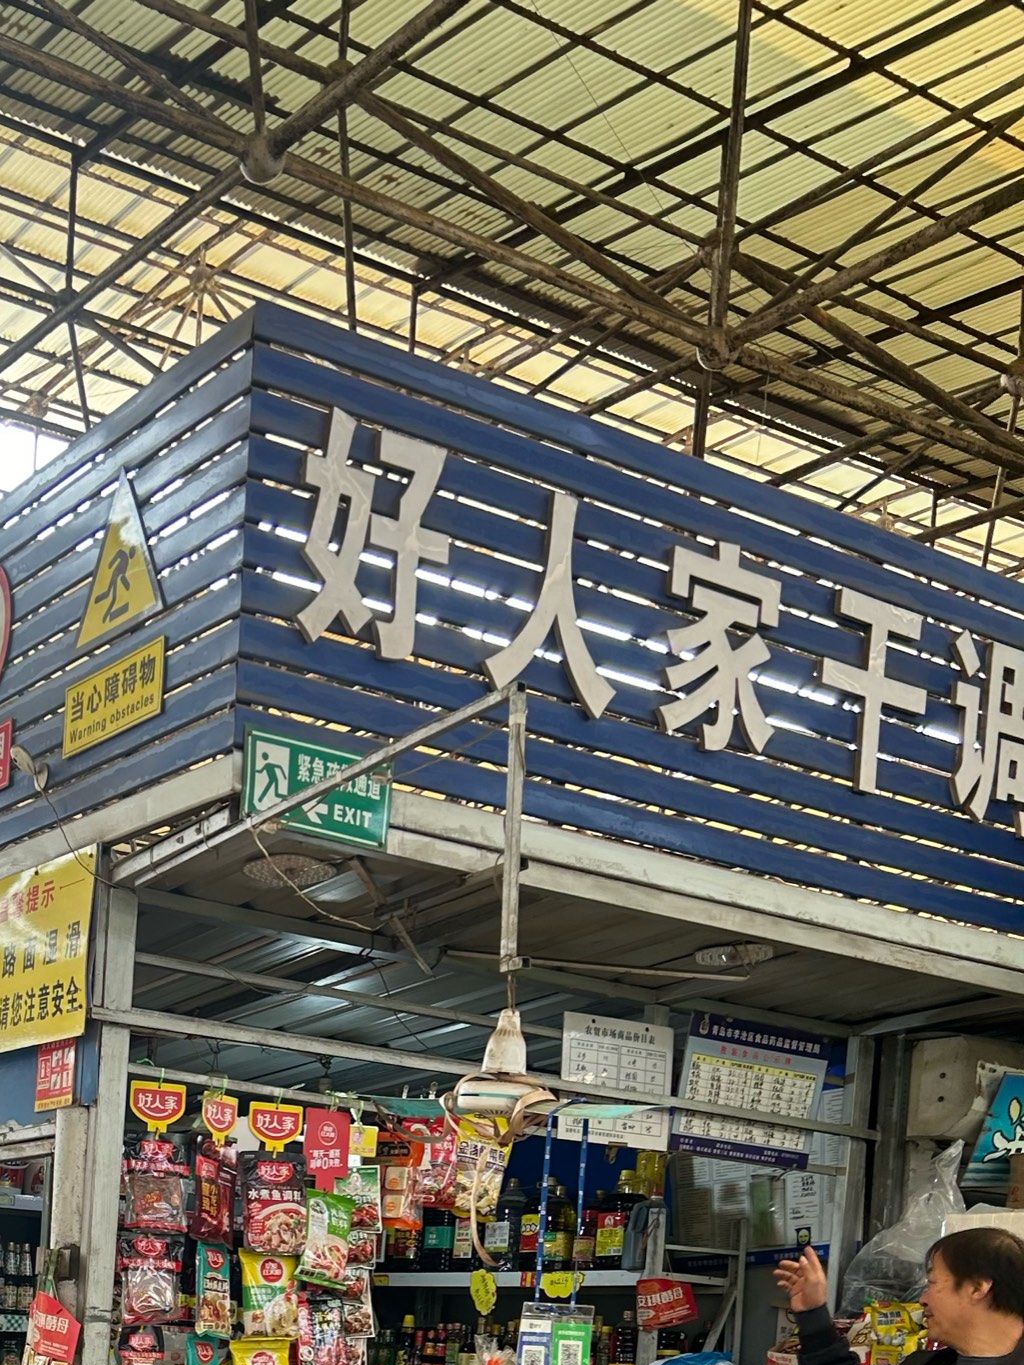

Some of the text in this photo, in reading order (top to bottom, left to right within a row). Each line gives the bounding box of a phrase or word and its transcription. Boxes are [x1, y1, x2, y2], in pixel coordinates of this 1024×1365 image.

[71, 653, 156, 723] 当心障碍物
[70, 692, 155, 744] Warning obstacles
[333, 804, 373, 829] EXIT
[1, 920, 82, 979] 路面湿滑
[137, 1092, 178, 1111] 好人家
[207, 1104, 233, 1123] 好人家
[256, 1113, 296, 1131] 好人家
[259, 1162, 292, 1178] 好人家
[247, 1189, 302, 1201] 水煮鱼调料
